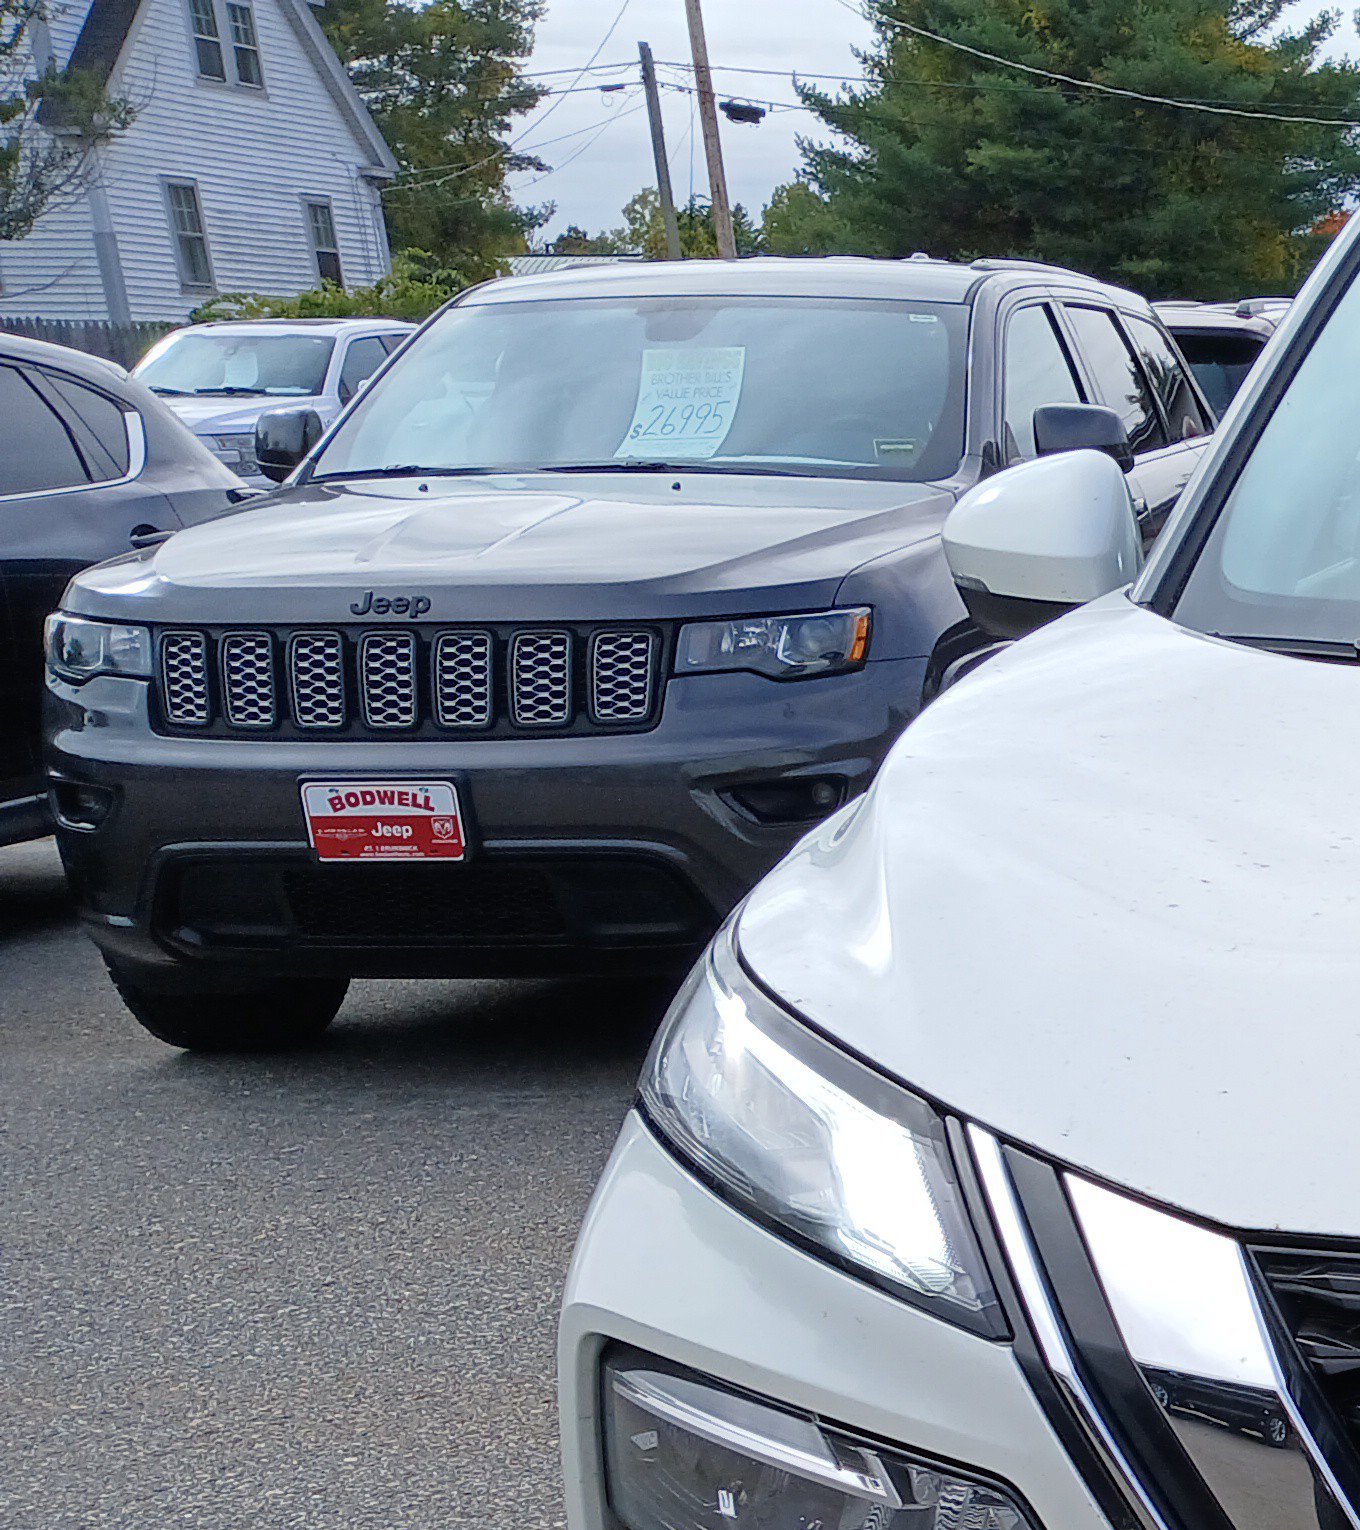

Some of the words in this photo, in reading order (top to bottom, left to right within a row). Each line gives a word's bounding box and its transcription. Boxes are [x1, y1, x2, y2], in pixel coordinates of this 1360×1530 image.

[350, 590, 431, 618] Jeep
[327, 789, 436, 813] BODWELL
[371, 821, 413, 839] Jeep
